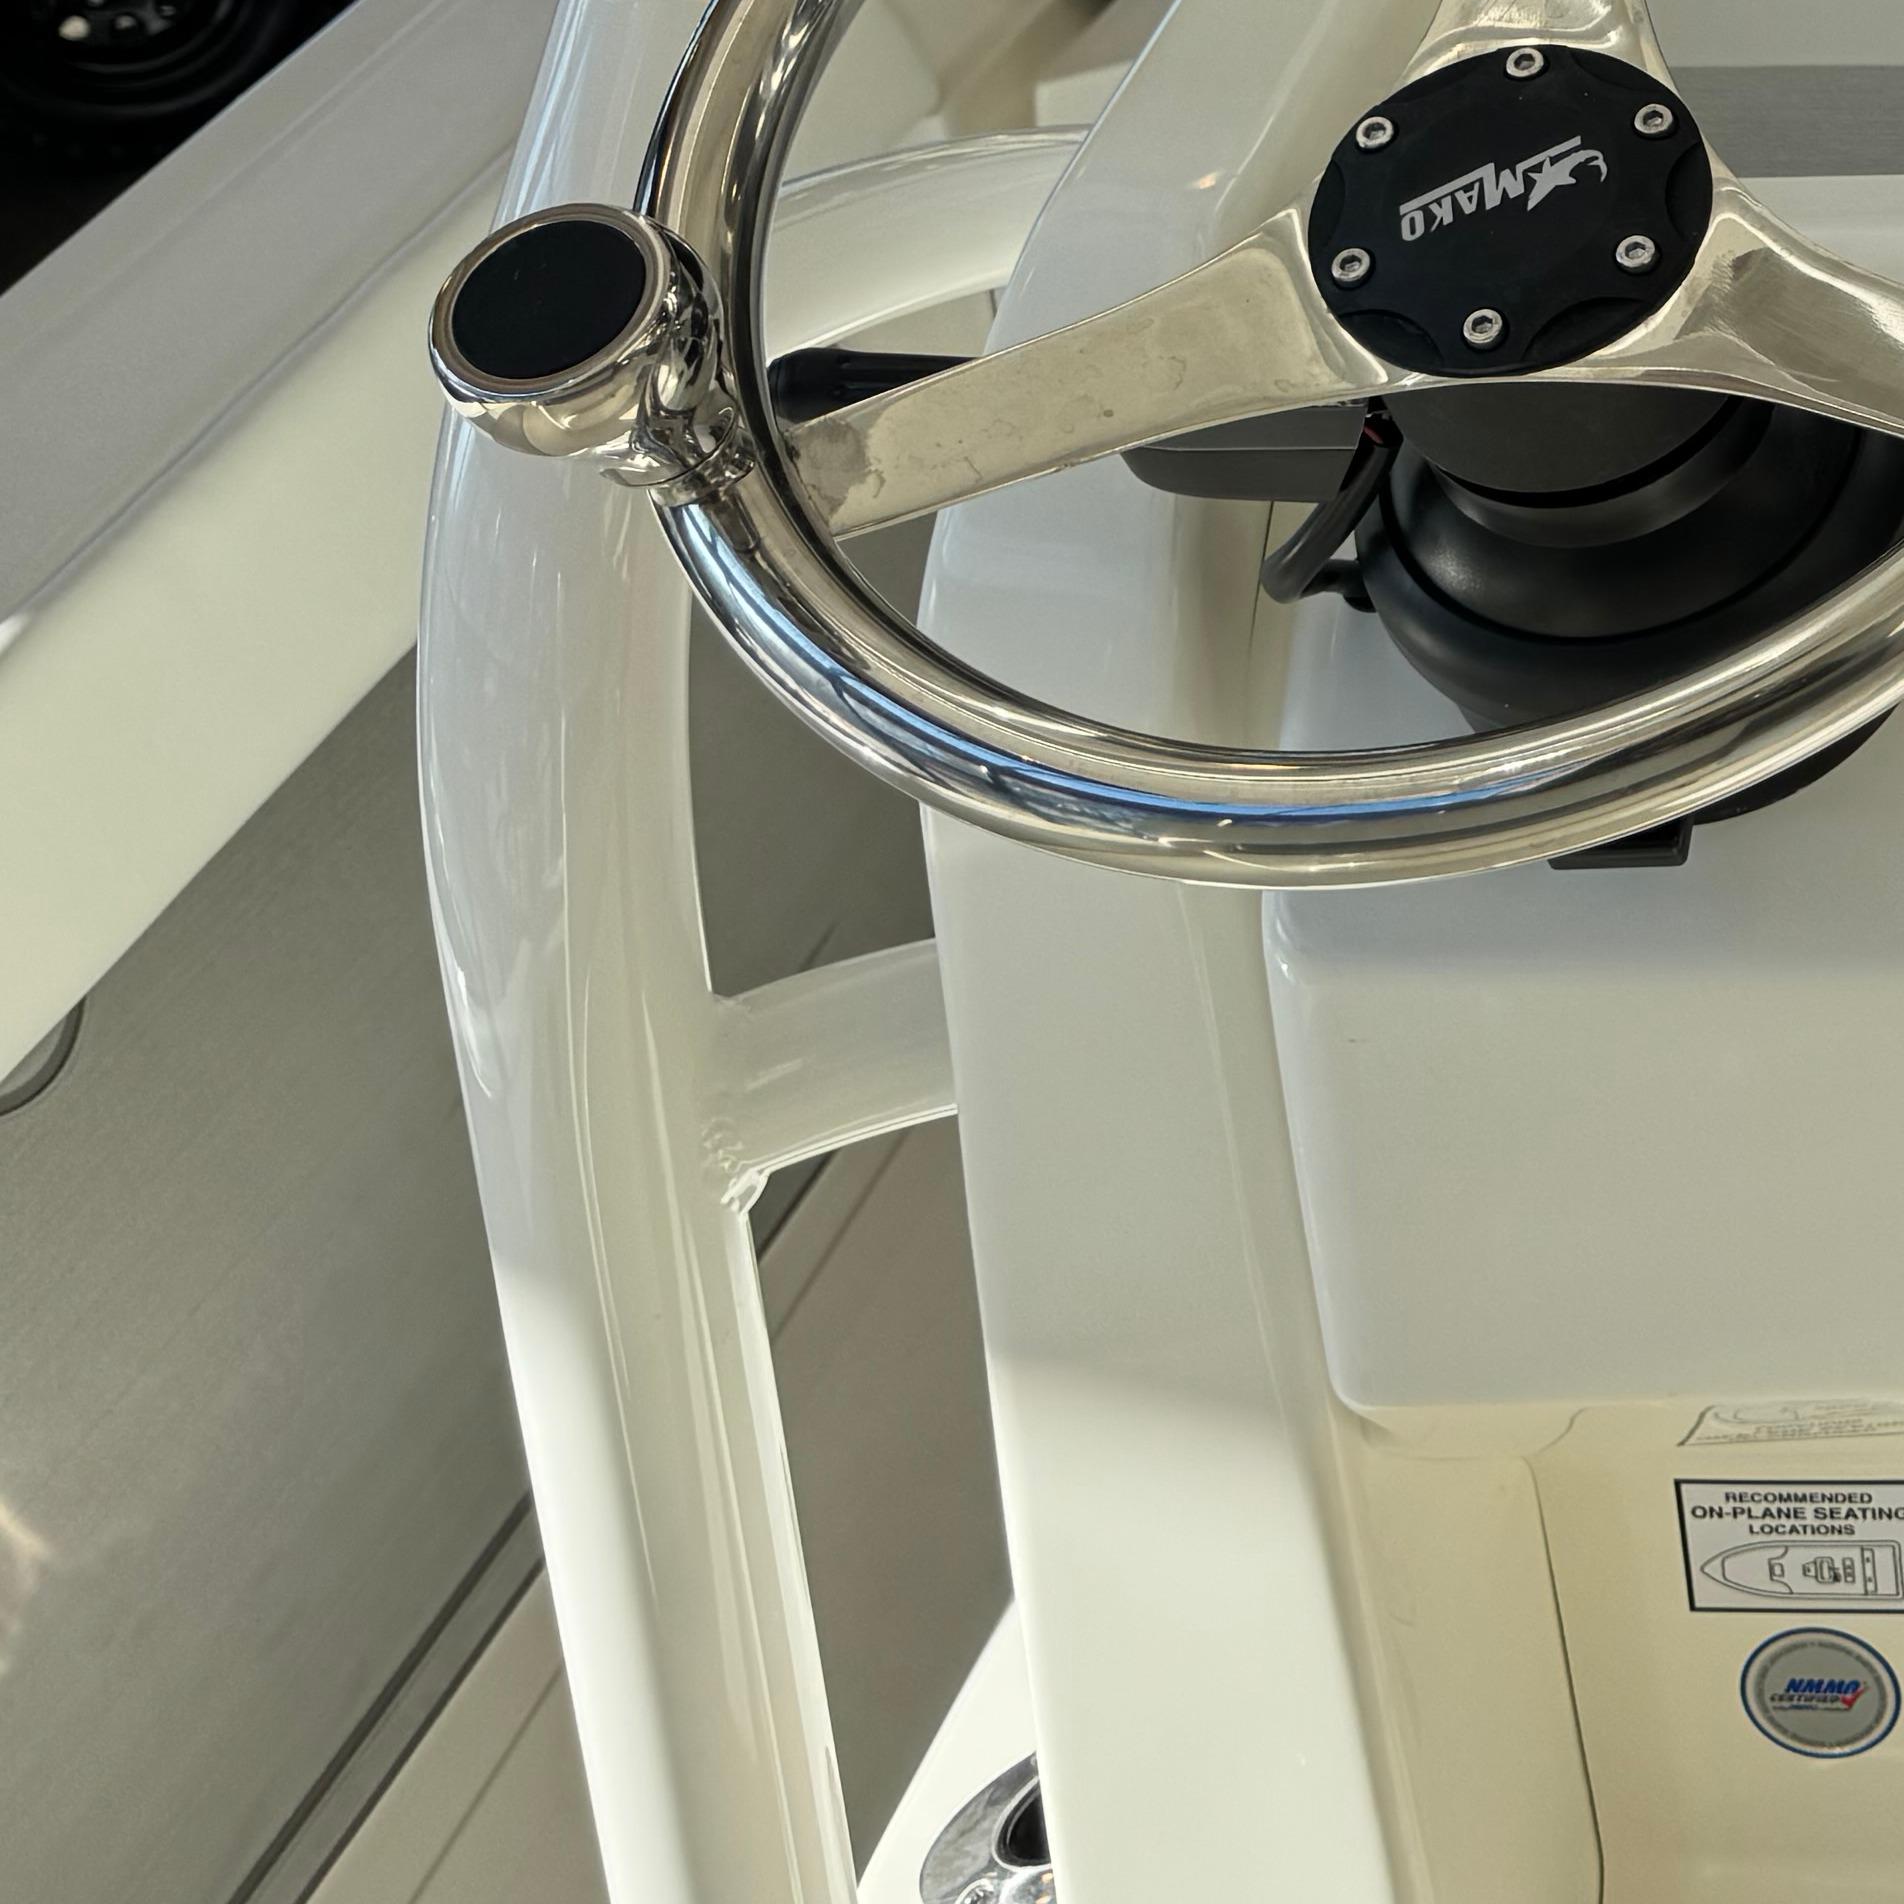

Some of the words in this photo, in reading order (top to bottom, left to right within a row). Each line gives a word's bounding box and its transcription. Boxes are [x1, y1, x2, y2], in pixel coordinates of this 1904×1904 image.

[1400, 140, 1582, 242] MAKO
[1725, 1492, 1873, 1504] RECOMMENDED
[1691, 1506, 1806, 1520] ON-PLANE
[1749, 1524, 1856, 1536] LOCATIONS
